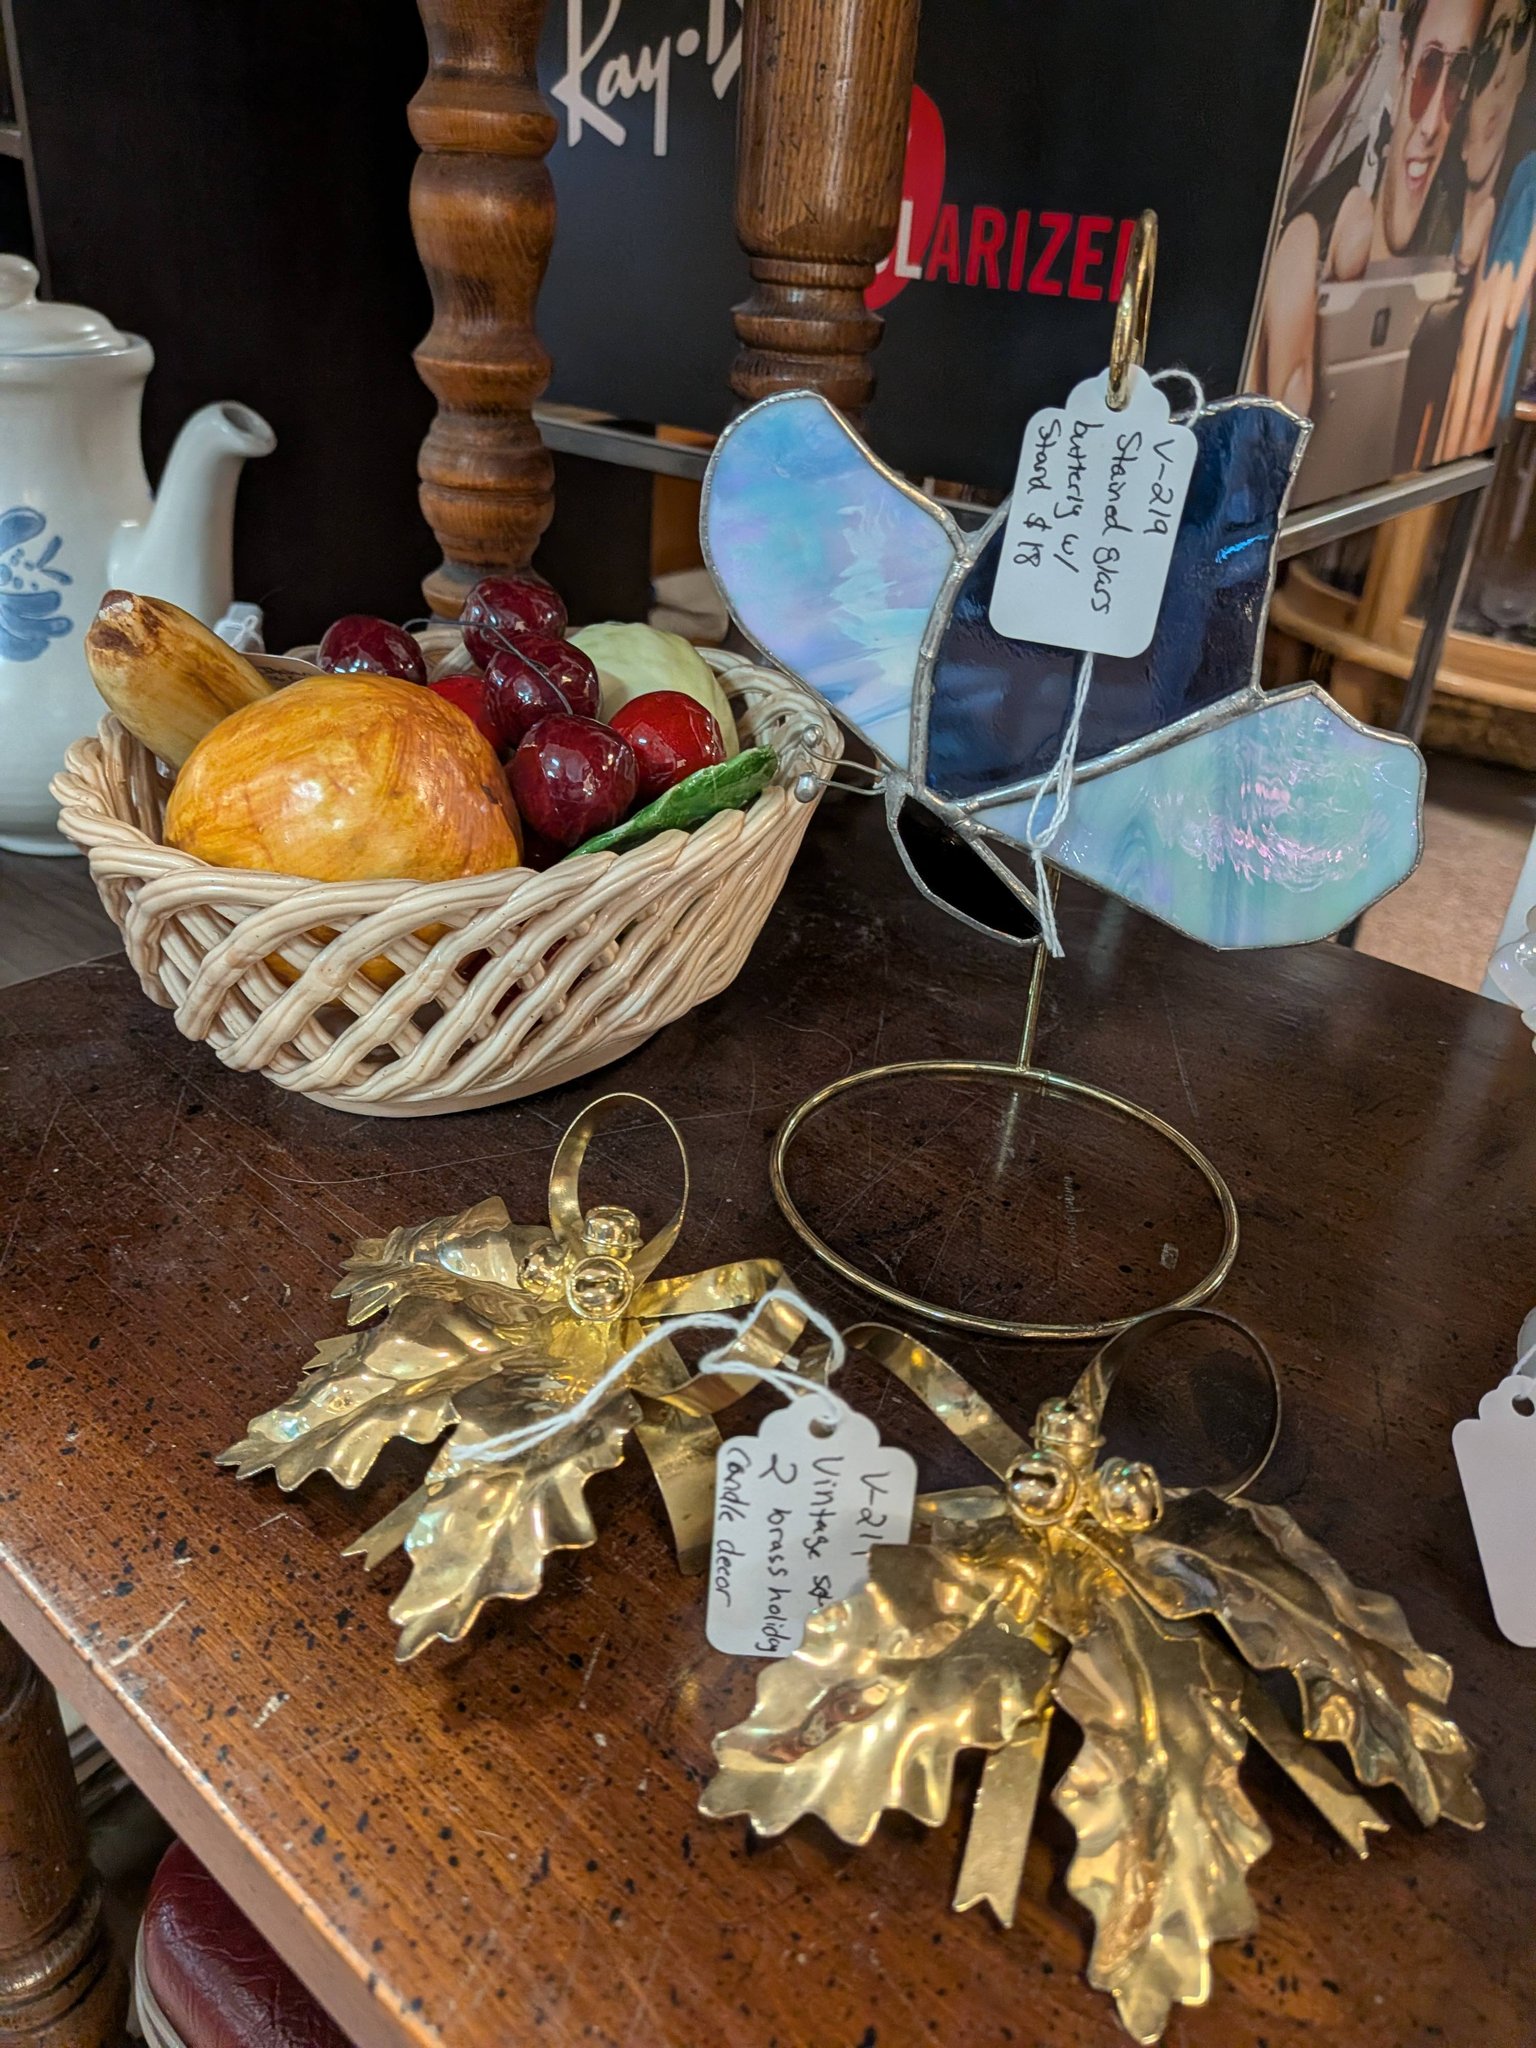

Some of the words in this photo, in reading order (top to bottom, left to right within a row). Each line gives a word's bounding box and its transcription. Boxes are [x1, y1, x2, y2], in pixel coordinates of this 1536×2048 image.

[875, 198, 1136, 303] LARIZE
[1026, 418, 1061, 494] Stand
[1102, 431, 1142, 536] Stained
[1144, 439, 1176, 535] V-219
[1091, 546, 1120, 615] glass
[758, 1453, 797, 1485] 2
[766, 1508, 792, 1577] brass
[803, 1456, 844, 1560] Vintage
[715, 1539, 746, 1609] decor
